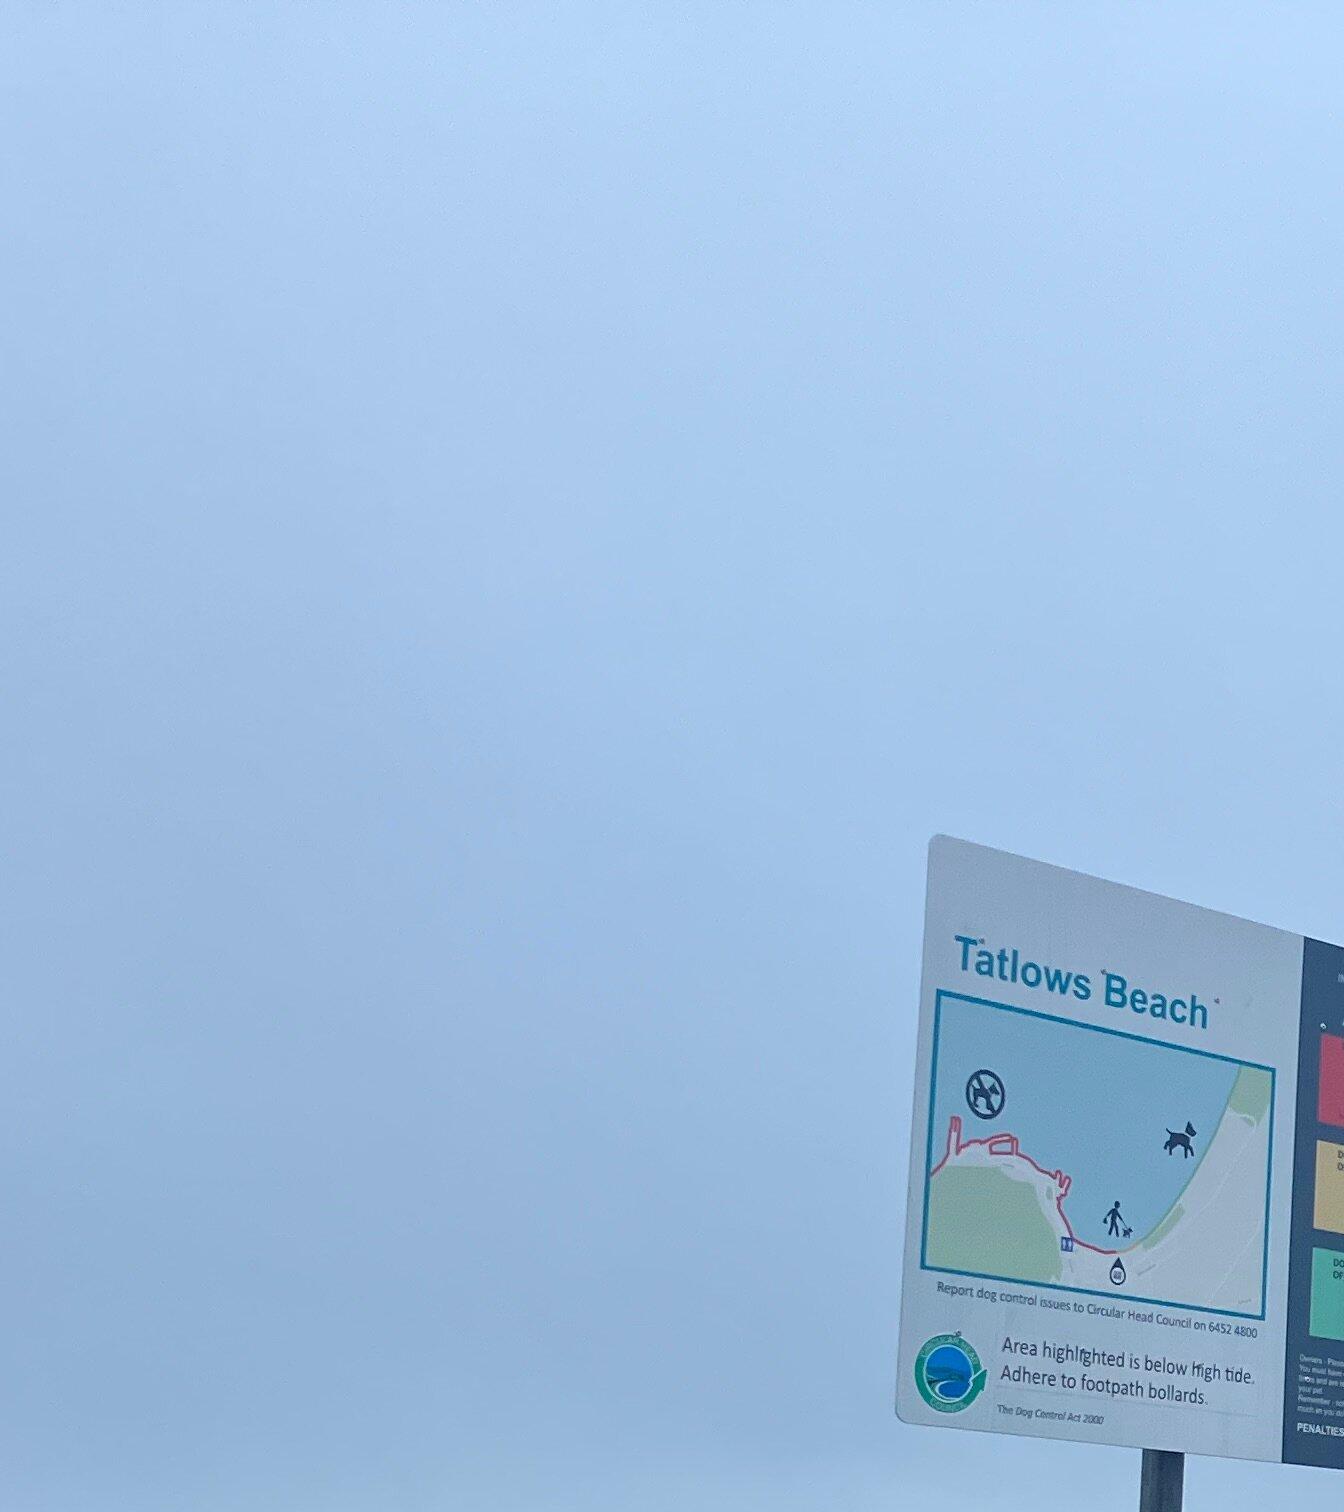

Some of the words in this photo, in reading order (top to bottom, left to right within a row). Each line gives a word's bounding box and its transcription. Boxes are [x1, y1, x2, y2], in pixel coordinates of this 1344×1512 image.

[954, 934, 1091, 1000] Tatlows
[1104, 972, 1207, 1029] Beach
[937, 1281, 974, 1297] Report
[976, 1287, 997, 1303] dog
[999, 1292, 1037, 1306] control
[1040, 1298, 1071, 1311] issues
[1073, 1302, 1084, 1313] to
[1087, 1303, 1124, 1319] Circular
[1128, 1309, 1153, 1323] Head
[1156, 1313, 1191, 1329] Council
[1194, 1321, 1206, 1331] on
[1208, 1321, 1232, 1335] 6452
[1234, 1325, 1257, 1339] 4800
[1001, 1336, 1037, 1356] Area
[1042, 1340, 1125, 1367] highlighted
[1129, 1352, 1140, 1370] is
[1144, 1354, 1187, 1376] below
[1191, 1360, 1221, 1383] high
[1225, 1366, 1254, 1384] tide.
[1000, 1364, 1056, 1387] Adhere
[1061, 1373, 1076, 1389] to
[1081, 1373, 1144, 1398] footpath
[1148, 1382, 1208, 1405] bollards.
[997, 1404, 1013, 1415] The
[1015, 1406, 1033, 1419] Dog
[1035, 1408, 1066, 1420] Control
[1067, 1412, 1081, 1422] Act
[1083, 1414, 1104, 1425] 2000
[1297, 1422, 1344, 1438] PENALTIES
